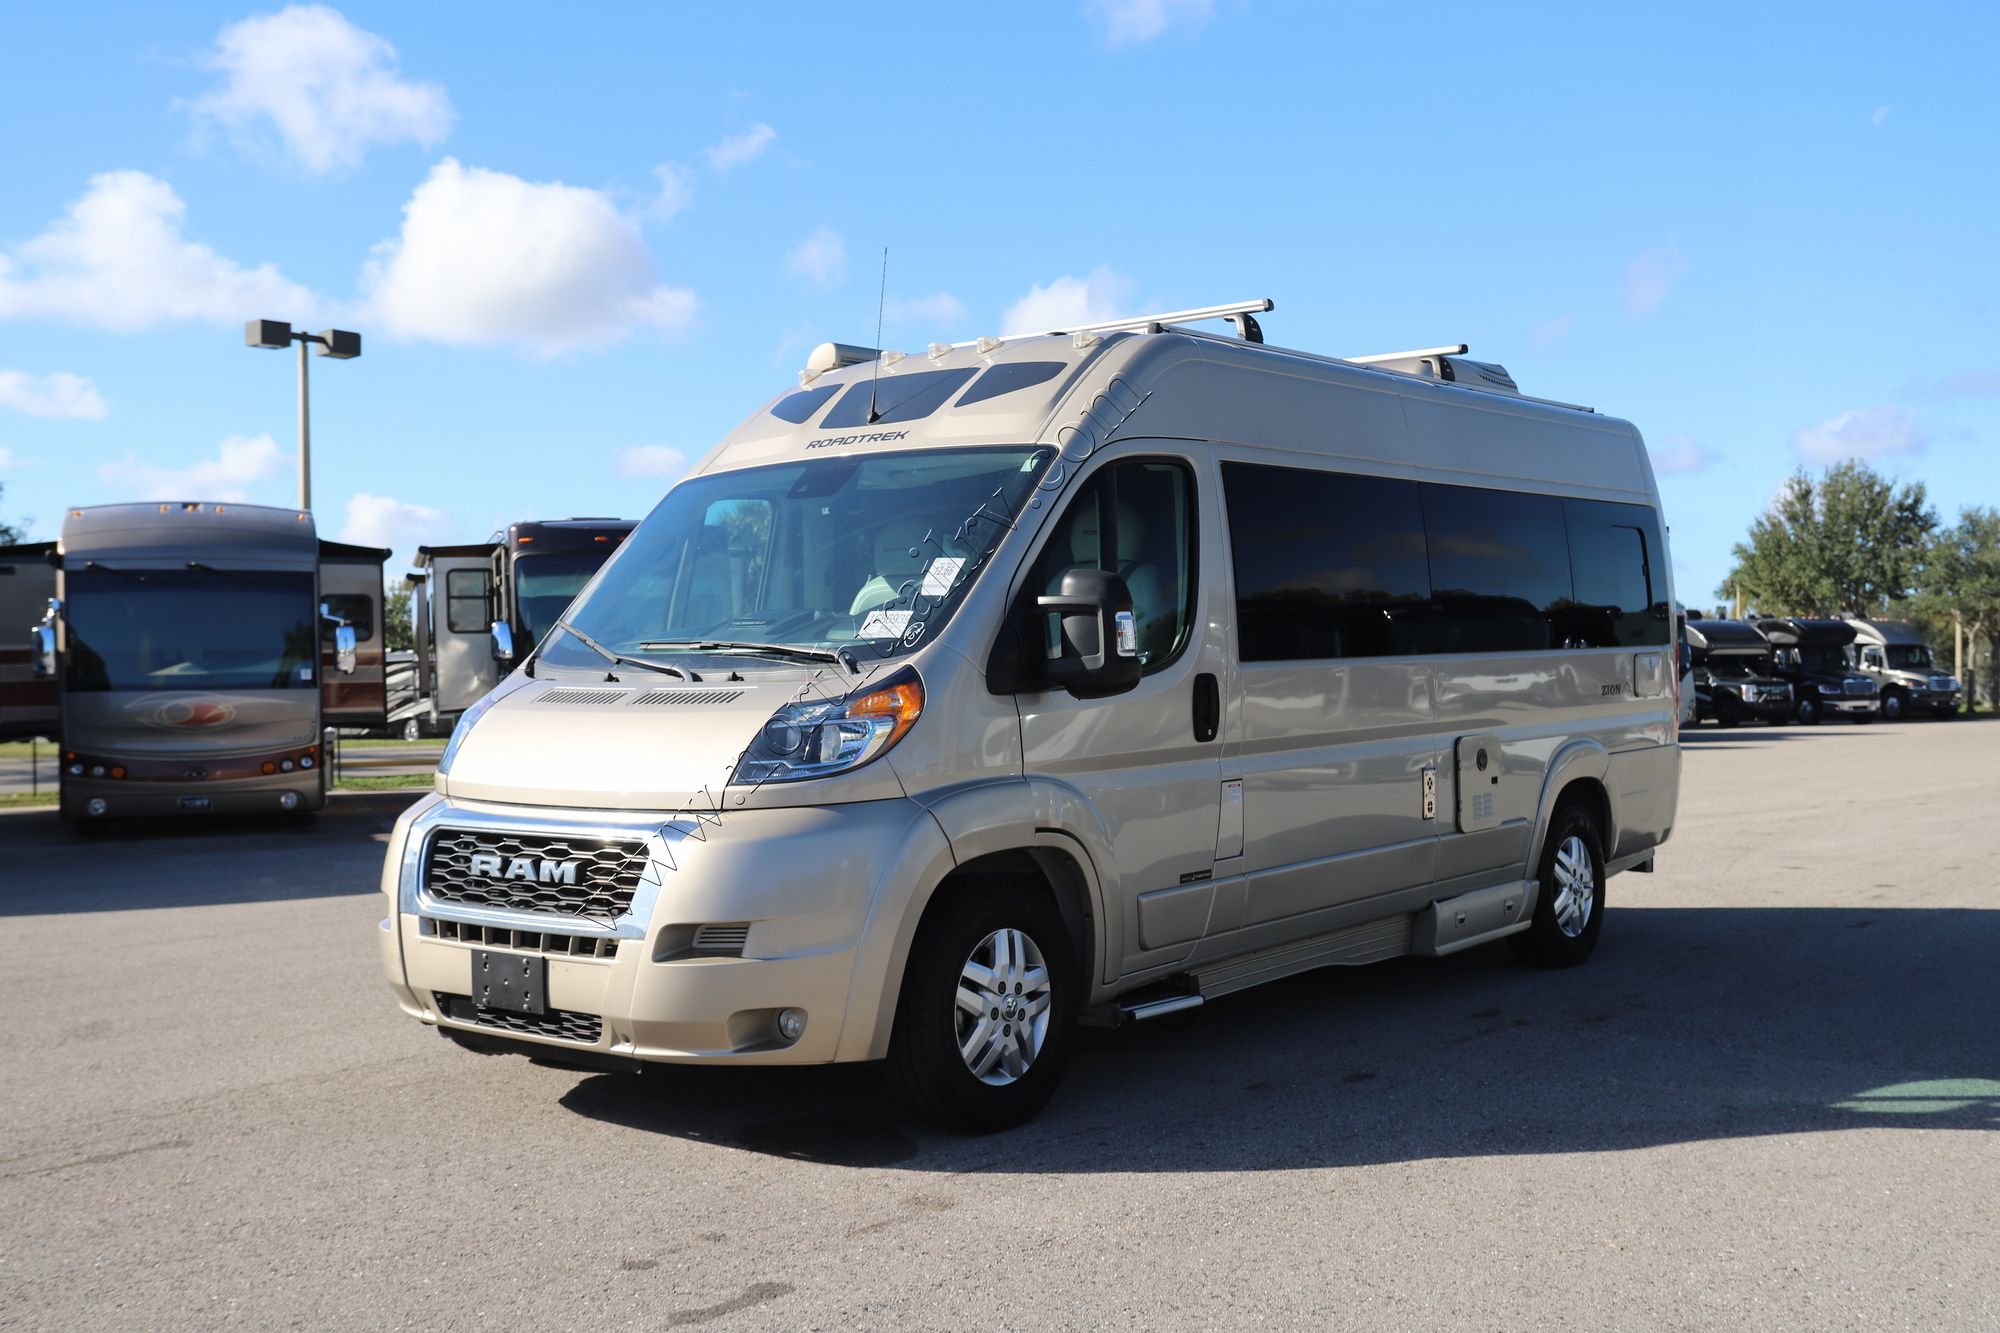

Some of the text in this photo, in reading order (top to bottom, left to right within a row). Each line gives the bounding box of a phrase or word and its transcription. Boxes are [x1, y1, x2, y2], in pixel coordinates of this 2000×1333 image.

[805, 430, 910, 450] ROADTREK
[1601, 683, 1622, 697] ZION
[470, 853, 580, 885] RAM
